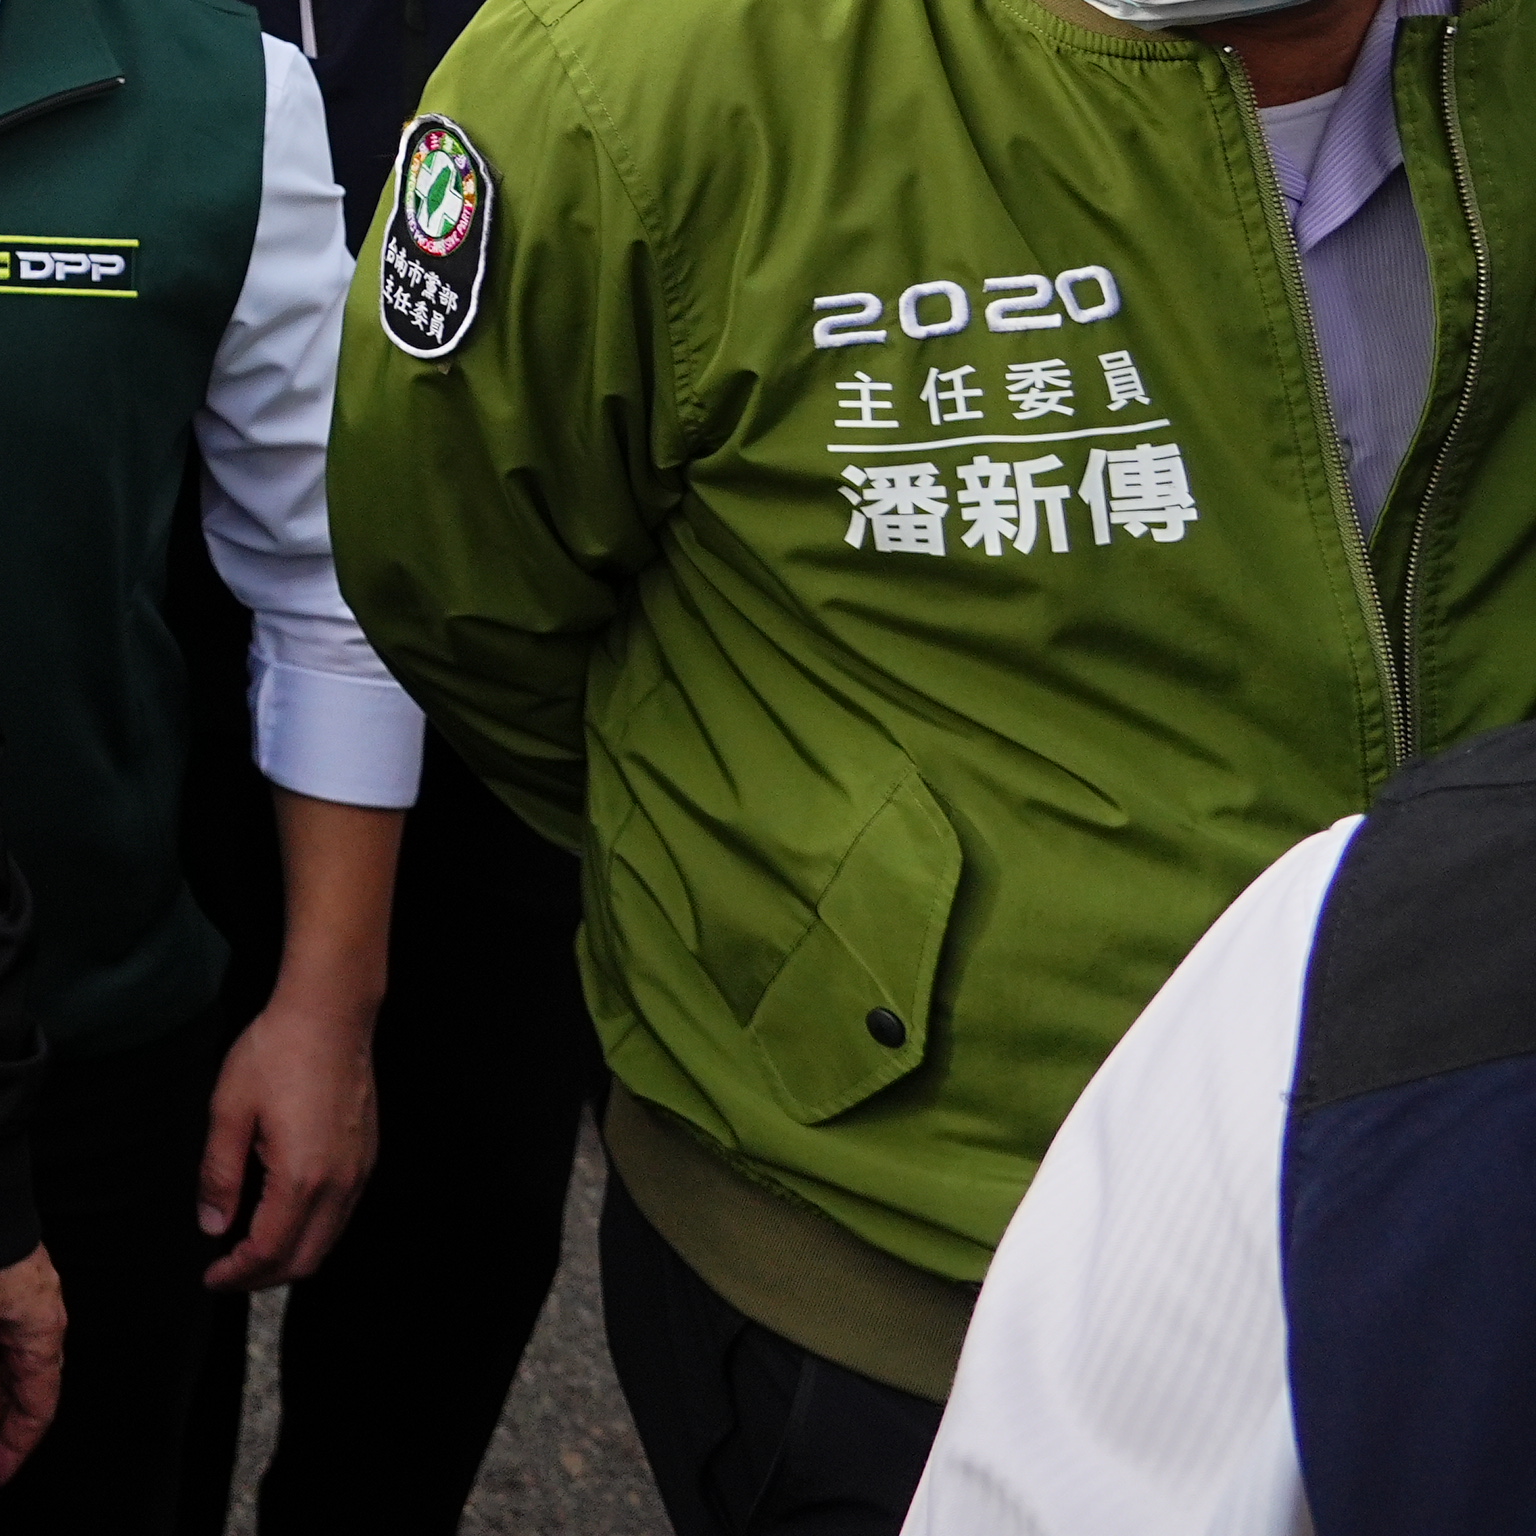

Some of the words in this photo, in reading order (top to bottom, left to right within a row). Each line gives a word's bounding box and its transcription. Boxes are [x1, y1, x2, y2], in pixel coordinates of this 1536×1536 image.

[15, 249, 126, 282] DPP
[812, 264, 1122, 349] 2020
[833, 349, 1152, 430] 主任委員
[837, 443, 1199, 558] 潘新傳
